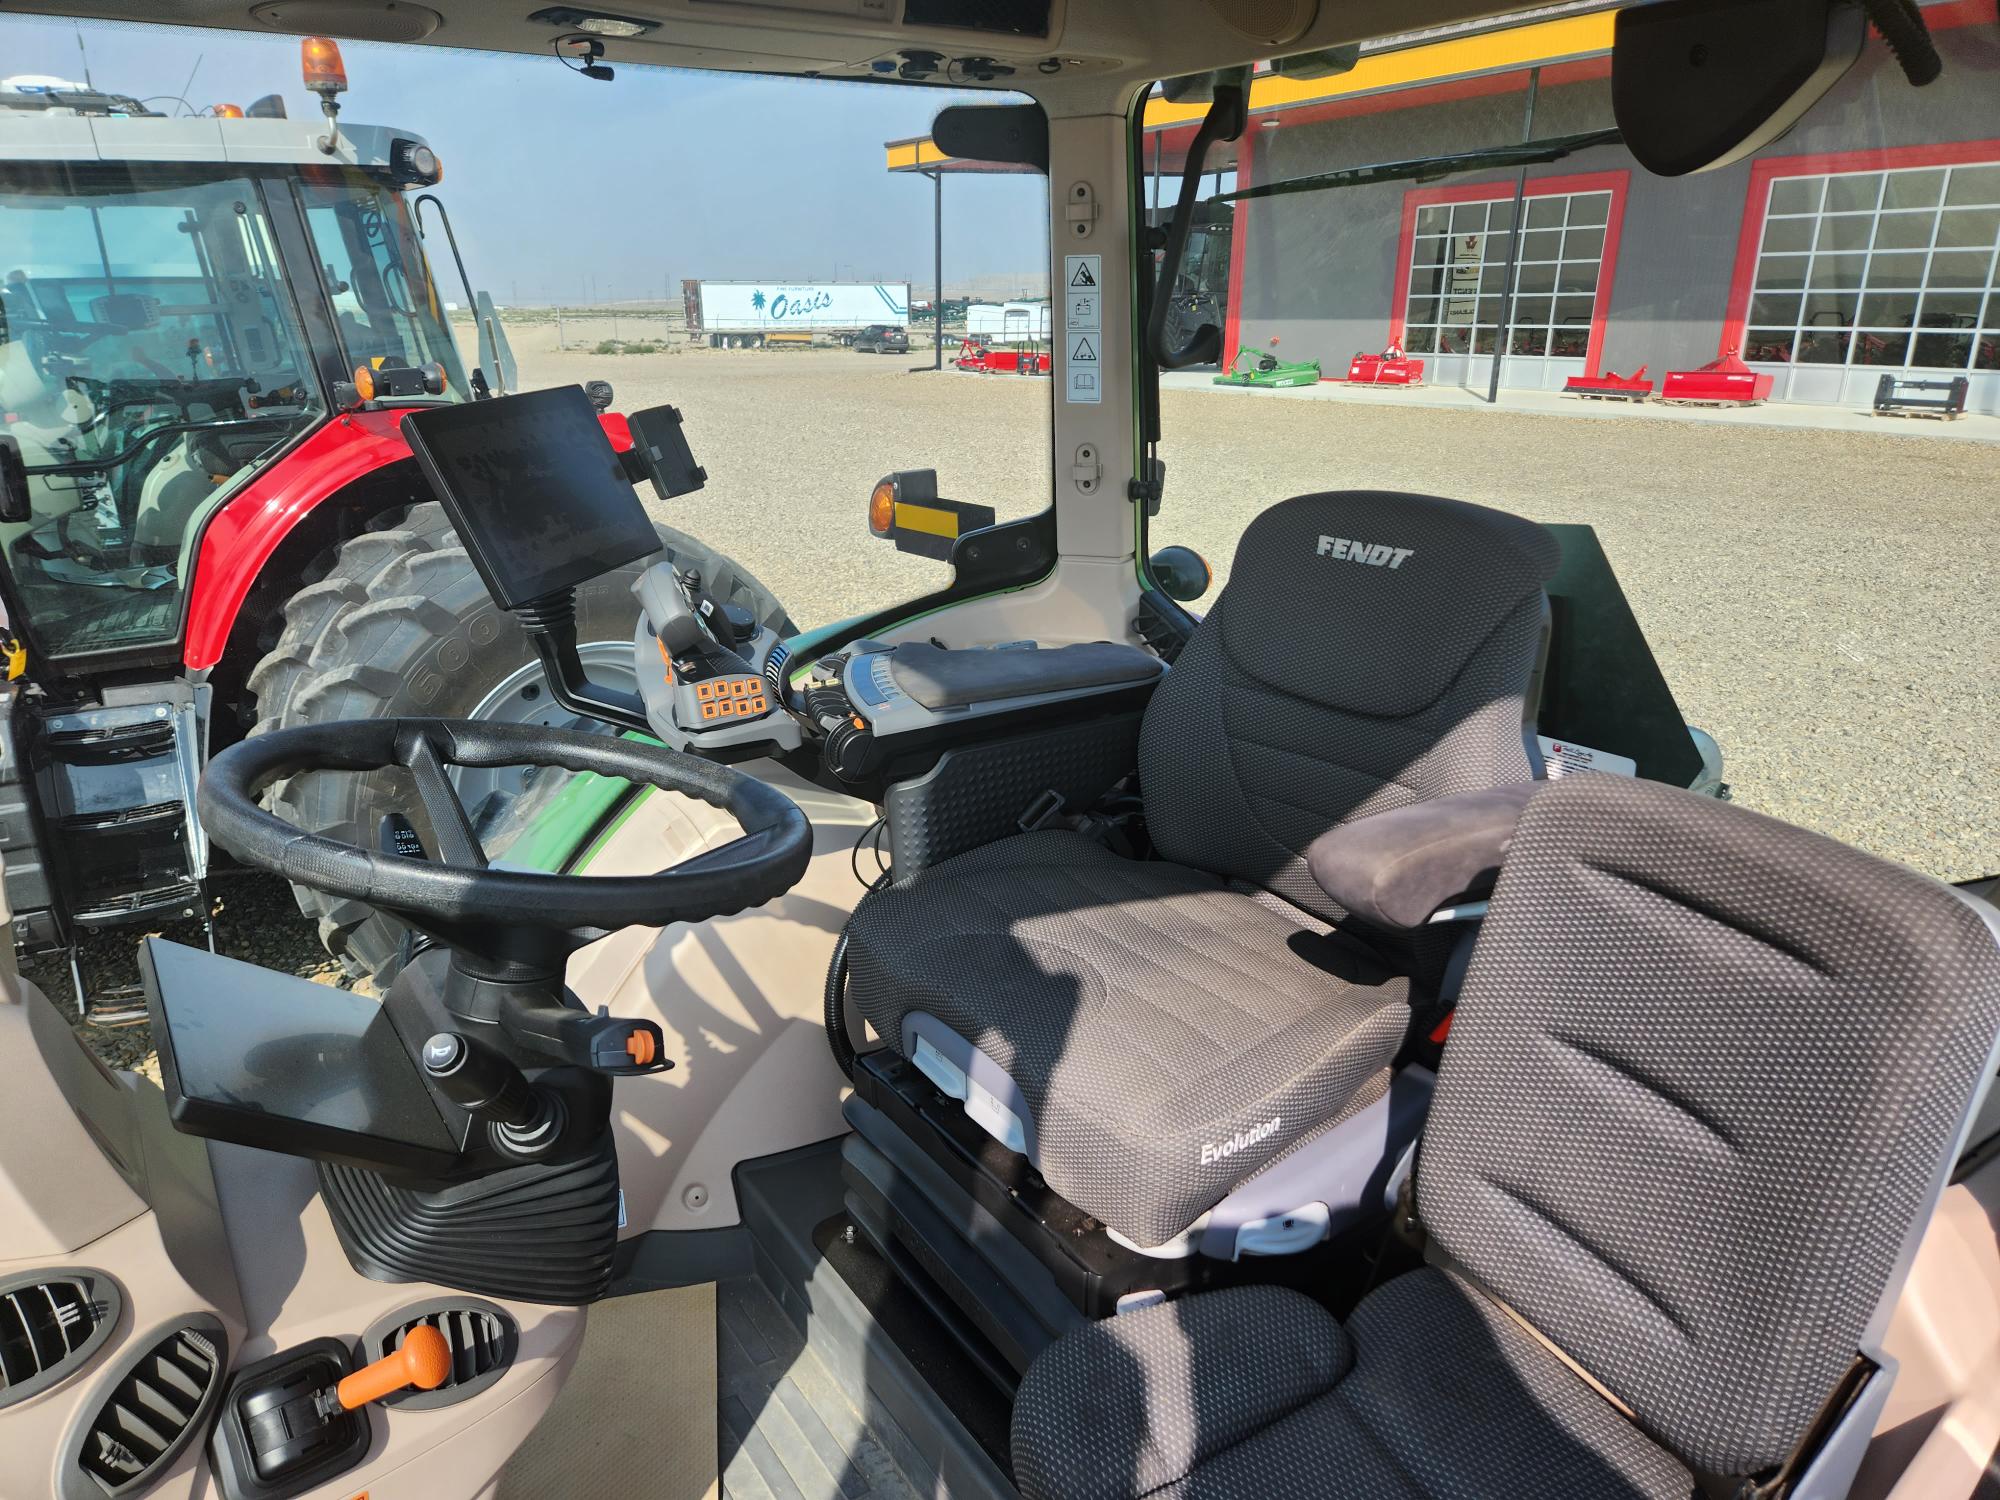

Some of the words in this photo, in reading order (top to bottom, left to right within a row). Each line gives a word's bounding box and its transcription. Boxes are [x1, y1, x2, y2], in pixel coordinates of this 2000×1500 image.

[771, 291, 833, 319] Oasis
[1317, 534, 1415, 569] FENDT
[1200, 1116, 1281, 1165] Evolution
